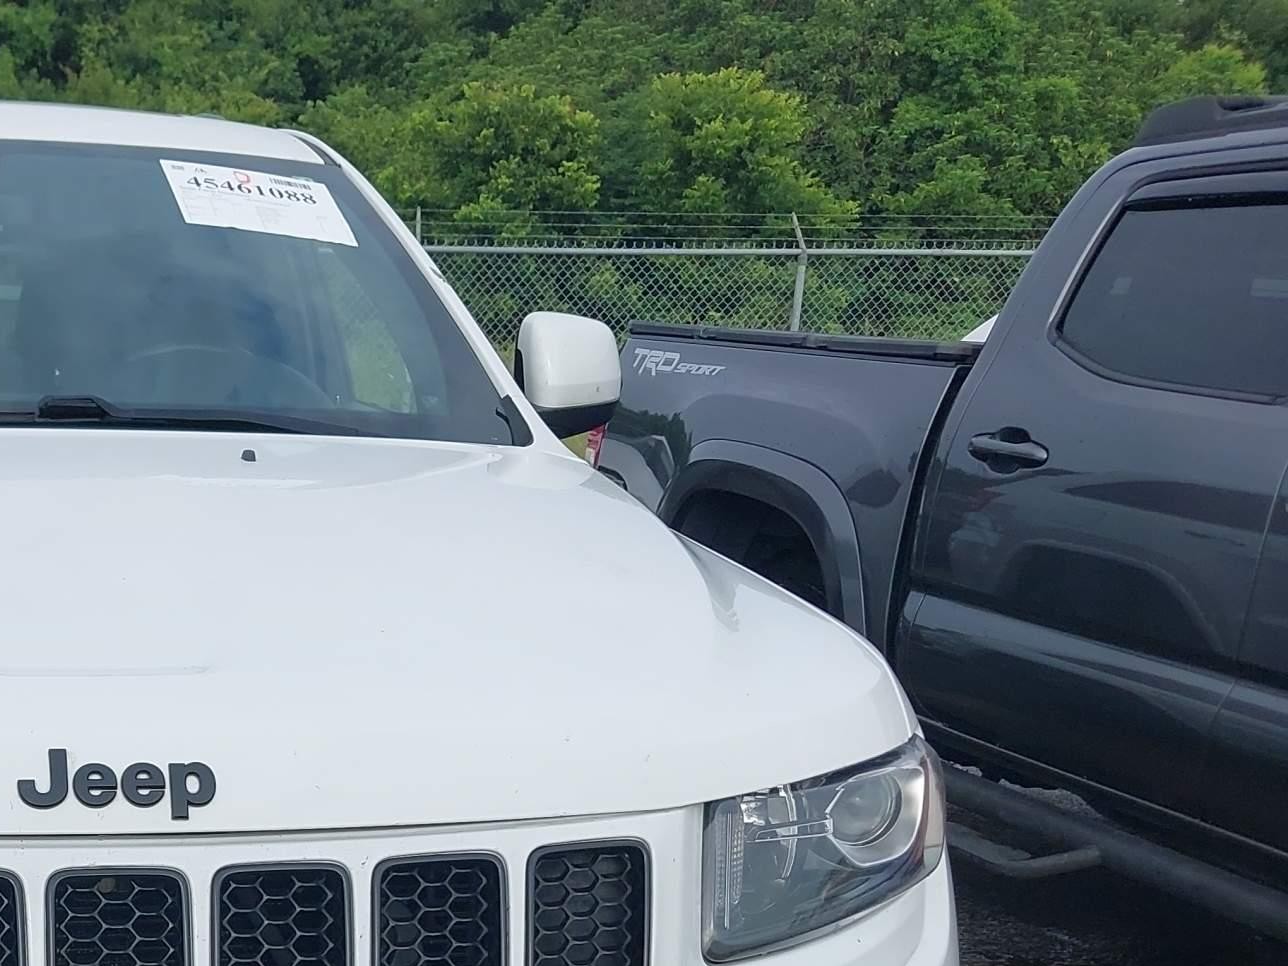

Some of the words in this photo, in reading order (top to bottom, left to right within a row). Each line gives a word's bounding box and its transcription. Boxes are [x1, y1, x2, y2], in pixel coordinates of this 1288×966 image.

[187, 176, 317, 205] 45461088
[632, 348, 681, 376] TRD
[674, 362, 727, 376] SPORT
[17, 748, 217, 821] Jeep
